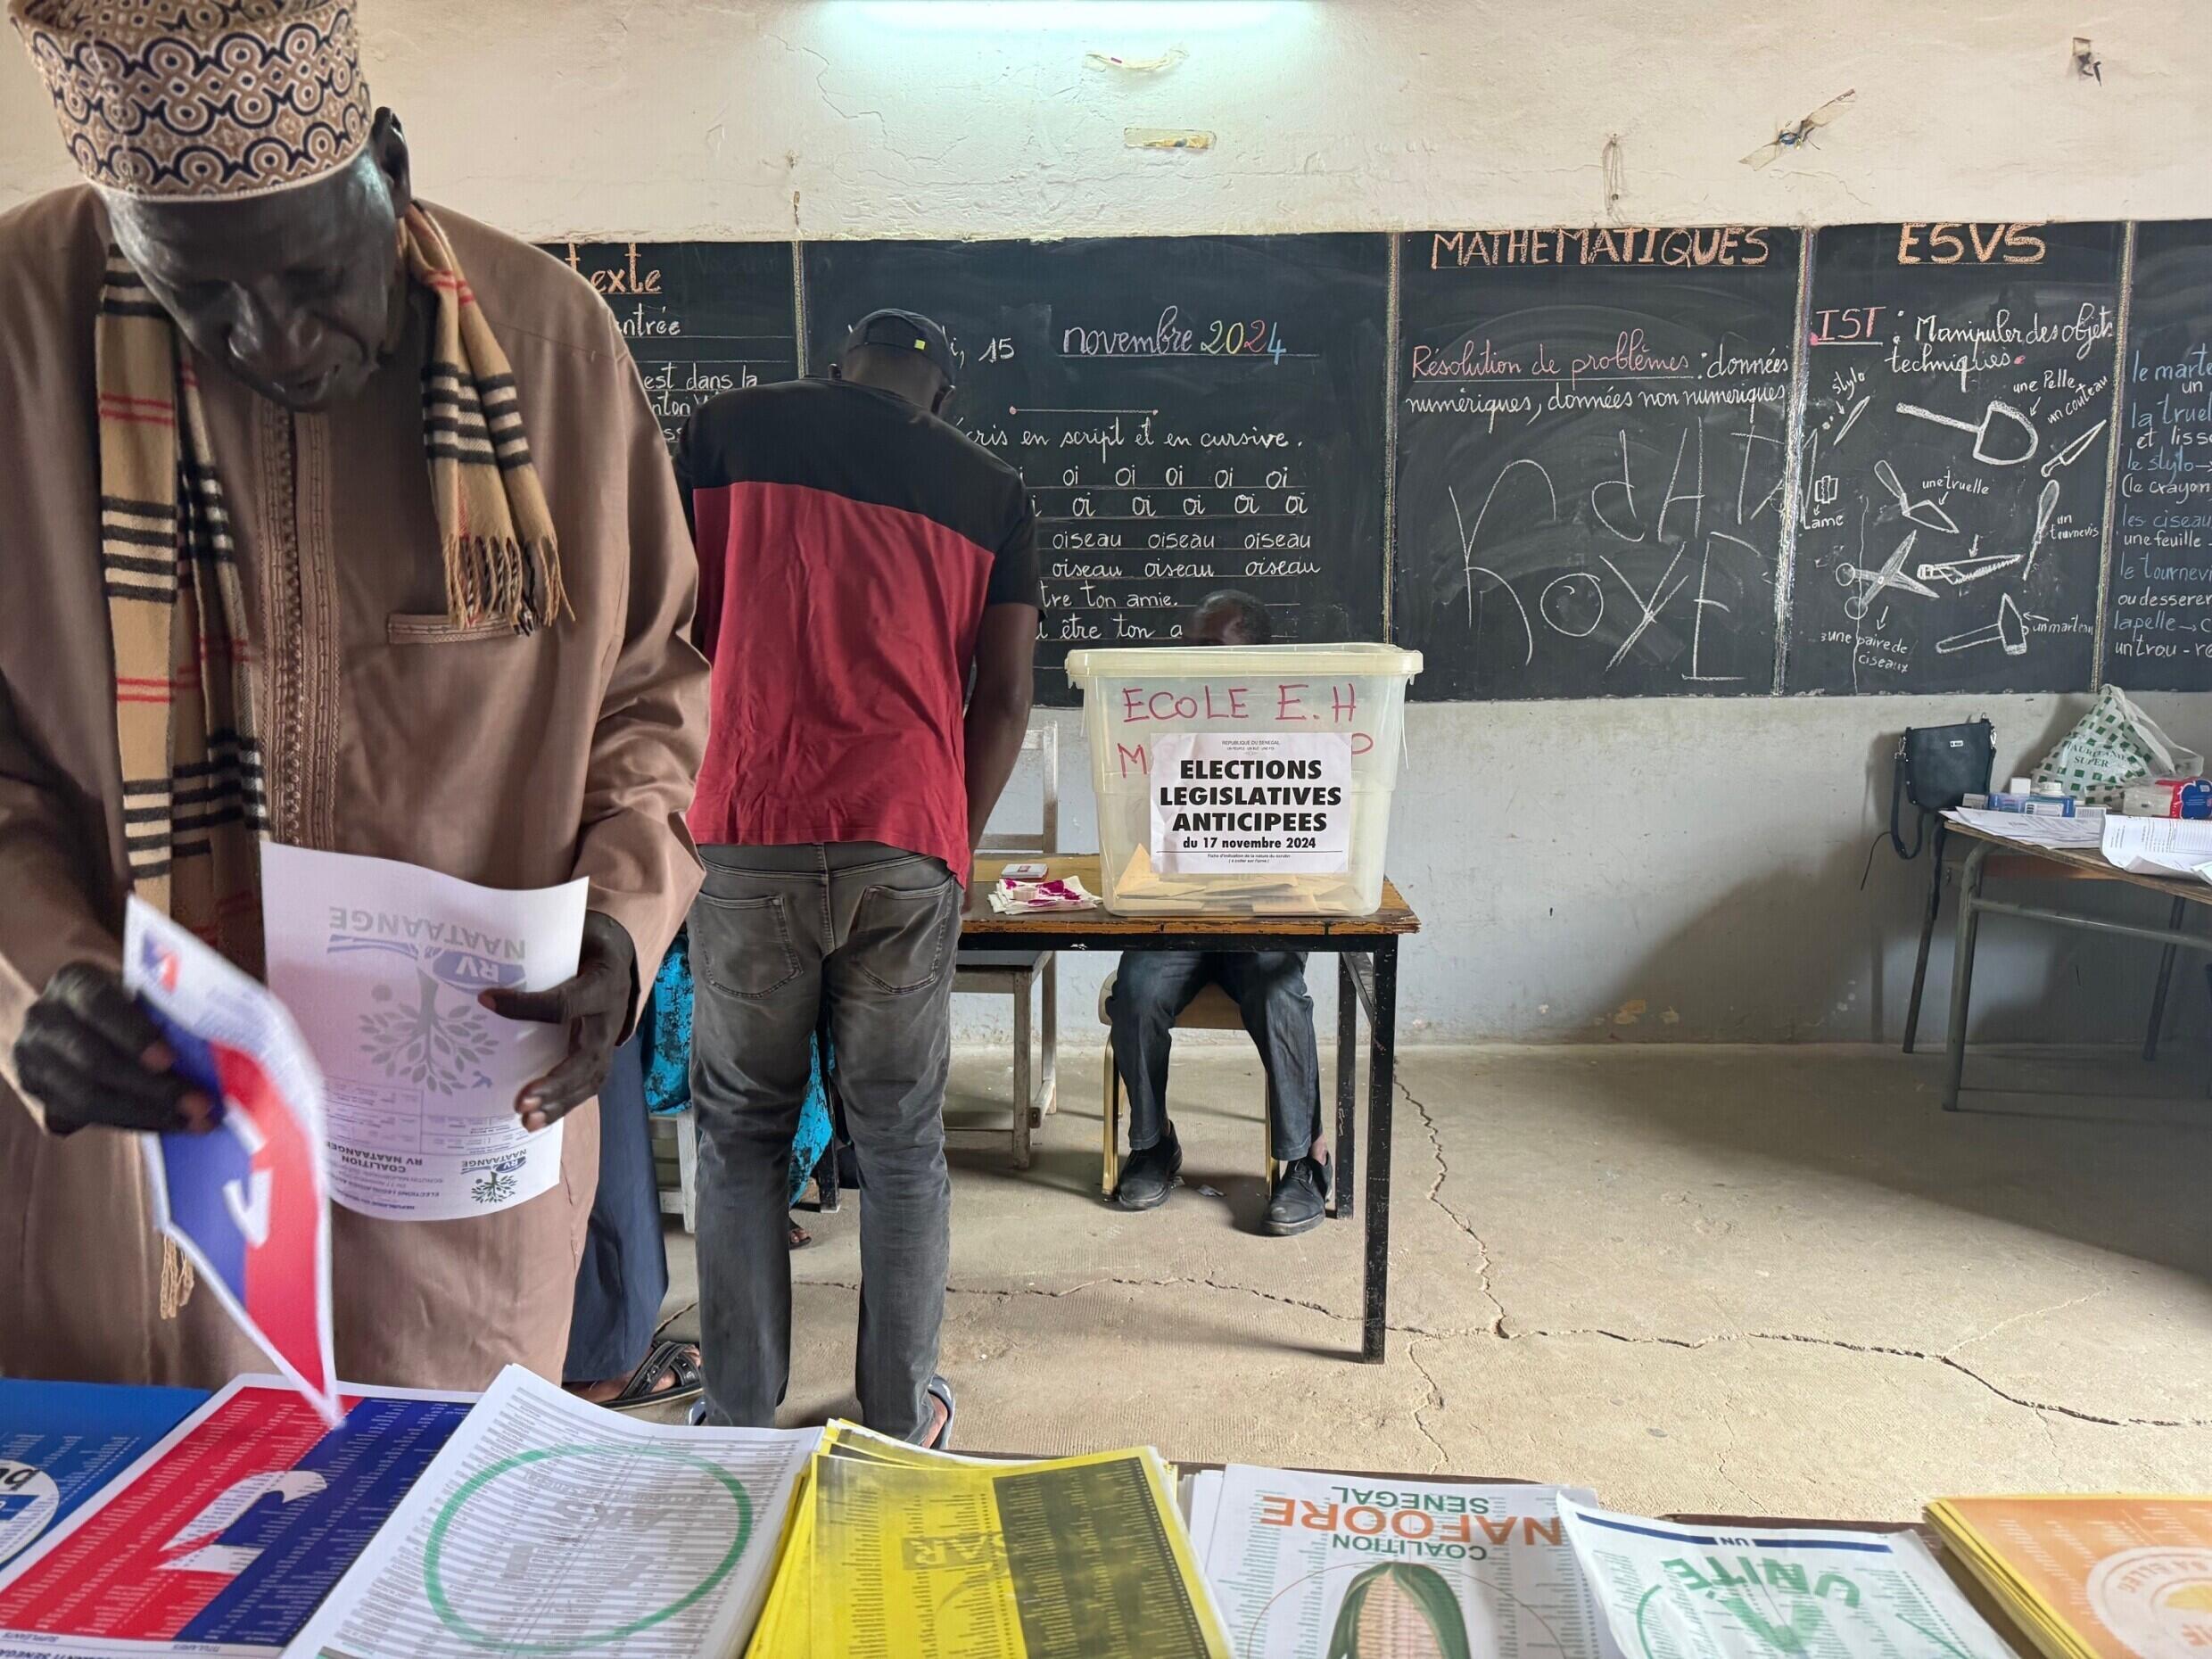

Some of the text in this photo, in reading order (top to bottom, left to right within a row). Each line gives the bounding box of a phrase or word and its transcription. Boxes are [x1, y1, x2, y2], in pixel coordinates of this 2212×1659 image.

[1431, 227, 1770, 269] MATHEMATIQUES
[618, 303, 681, 338] ntrée
[1816, 306, 1886, 342] IST
[1915, 310, 2023, 359] Manipuler
[2025, 313, 2059, 344] des
[2060, 302, 2115, 360] objets
[1062, 305, 1193, 355] novembre
[1200, 319, 1287, 365] 2024
[1412, 339, 1522, 378] Résolution
[1531, 343, 1561, 376] de
[2133, 349, 2149, 384] le
[644, 362, 757, 390] est dans la
[1831, 366, 1866, 400] stylo
[2013, 380, 2038, 393] une
[2182, 380, 2203, 394] un
[1548, 380, 1633, 410] données
[1638, 390, 1680, 408] non
[2047, 376, 2109, 425] un couteau
[2132, 401, 2153, 429] la
[1020, 430, 1046, 445] en
[1060, 417, 1124, 464] script
[1134, 417, 1155, 446] et
[1163, 431, 1193, 447] en
[2136, 426, 2158, 450] et
[1062, 466, 1080, 487] oi
[1115, 465, 1136, 486] oi
[1165, 465, 1184, 486] oi
[1215, 466, 1234, 488] oi
[1265, 465, 1290, 488] oi
[2127, 444, 2194, 487] le stylo
[1072, 493, 1097, 517] oi
[1132, 494, 1157, 516] oi
[1183, 494, 1207, 516] oi
[1234, 492, 1260, 516] oi
[1284, 491, 1309, 515] oi
[2150, 481, 2210, 505] crayon
[1803, 512, 1845, 531] Lame
[2057, 515, 2072, 524] un
[2122, 503, 2147, 527] les
[1052, 531, 1312, 550] oiseau oiseau oiseau
[2125, 530, 2201, 548] une feuille
[1052, 555, 1322, 578] oiseau oiseau oiseau
[2120, 551, 2134, 580] le
[1039, 581, 1178, 608] tre ton amie.
[2117, 594, 2137, 606] ou
[1060, 613, 1102, 640] être
[1112, 614, 1157, 639] ton
[1858, 651, 1909, 673] ciseaux
[1123, 685, 1249, 722] ECOLE
[1180, 760, 1322, 780] ELECTIONS
[2074, 755, 2109, 767] SUPER
[1160, 787, 1341, 806] LEGISLATIVES
[1172, 813, 1327, 832] ANTICIPEES
[1183, 837, 1316, 848] du 17 novembre 2024
[329, 905, 526, 961] NAATAANGE
[455, 957, 499, 982] RV
[342, 1156, 407, 1174] COALITION
[407, 1156, 423, 1166] RV
[461, 1149, 526, 1168] NAATAANGE
[503, 1160, 519, 1170] RV
[1332, 1486, 1490, 1515] SENEGAL
[1260, 1495, 1563, 1546] NAFOORE
[1332, 1535, 1488, 1561] COALITION
[1721, 1536, 1750, 1548] UN
